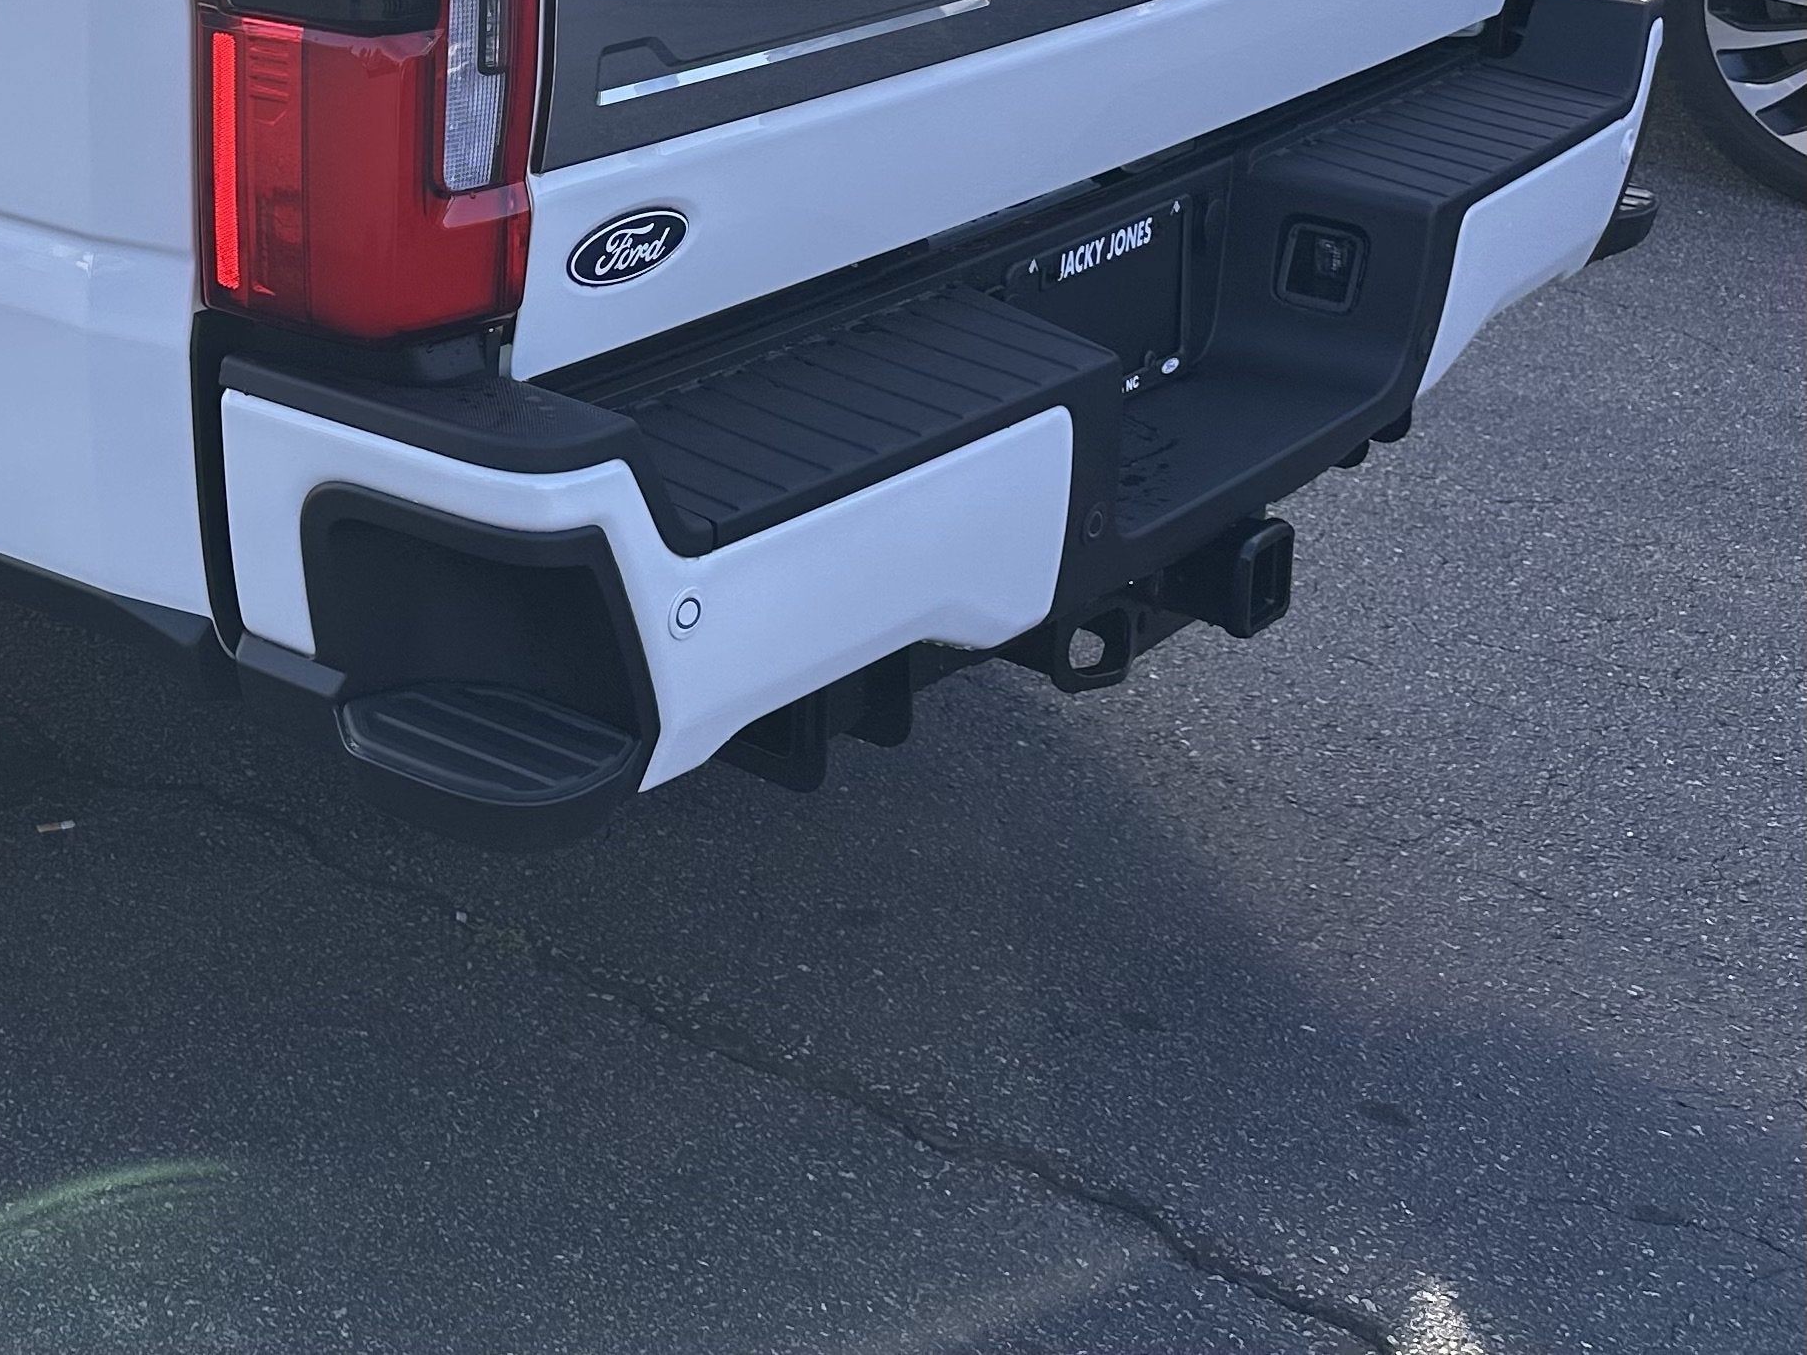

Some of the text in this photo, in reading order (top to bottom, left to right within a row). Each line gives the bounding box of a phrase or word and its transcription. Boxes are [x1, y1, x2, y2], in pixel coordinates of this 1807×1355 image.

[595, 223, 670, 275] Ford
[1057, 216, 1153, 282] JACKY JONES
[1125, 375, 1140, 393] NC
